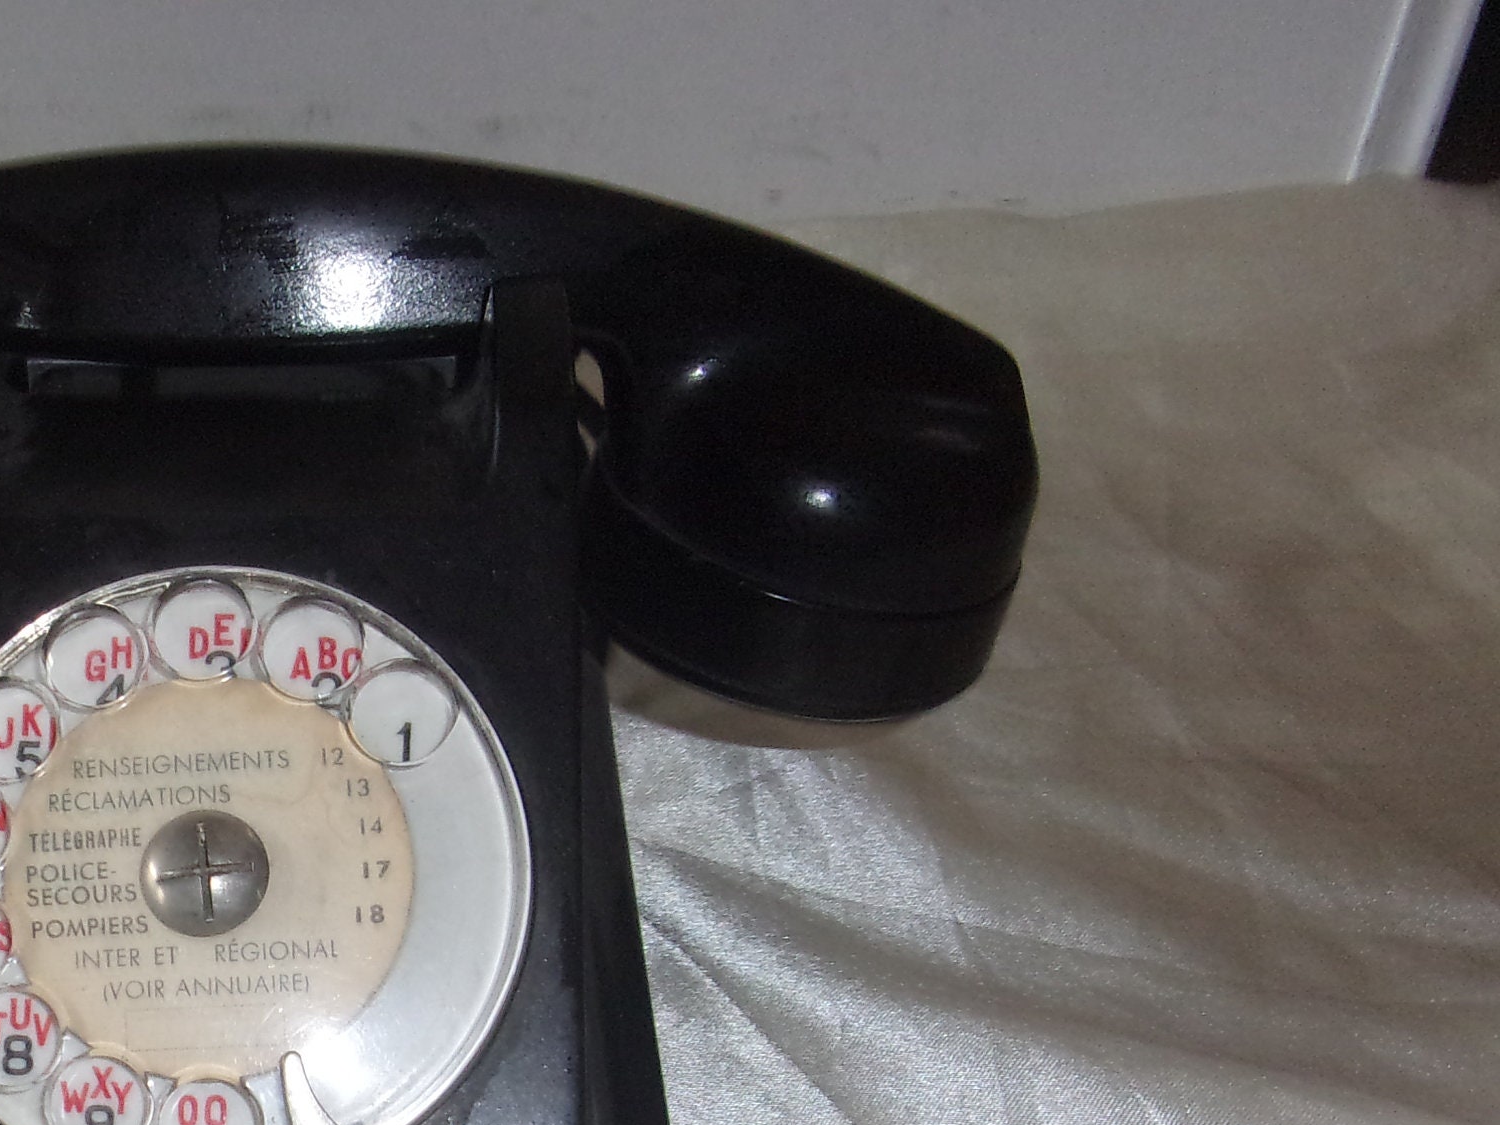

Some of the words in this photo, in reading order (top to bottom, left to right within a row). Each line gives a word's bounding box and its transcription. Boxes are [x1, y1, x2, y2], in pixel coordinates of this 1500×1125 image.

[289, 636, 362, 680] ABC
[396, 721, 412, 762] 1
[15, 740, 42, 779] 5
[73, 749, 290, 779] RENSEIGNEMENTS
[321, 747, 344, 766] 12
[48, 783, 231, 812] RÉCLAMATIONS
[346, 778, 370, 798] 13
[360, 816, 382, 835] 14
[26, 861, 117, 883] POLICE-
[363, 860, 391, 879] 17
[27, 883, 137, 907] SECOURS
[31, 915, 149, 939] POMPIERS
[355, 904, 385, 924] 18
[75, 949, 140, 969] INTER
[154, 946, 179, 965] ET
[215, 938, 338, 963] RÉGIONAL
[103, 980, 165, 1002] (VOIR
[175, 973, 309, 998] ANNUAIRE)
[2, 1034, 33, 1075] 8
[60, 1066, 132, 1114] WXY
